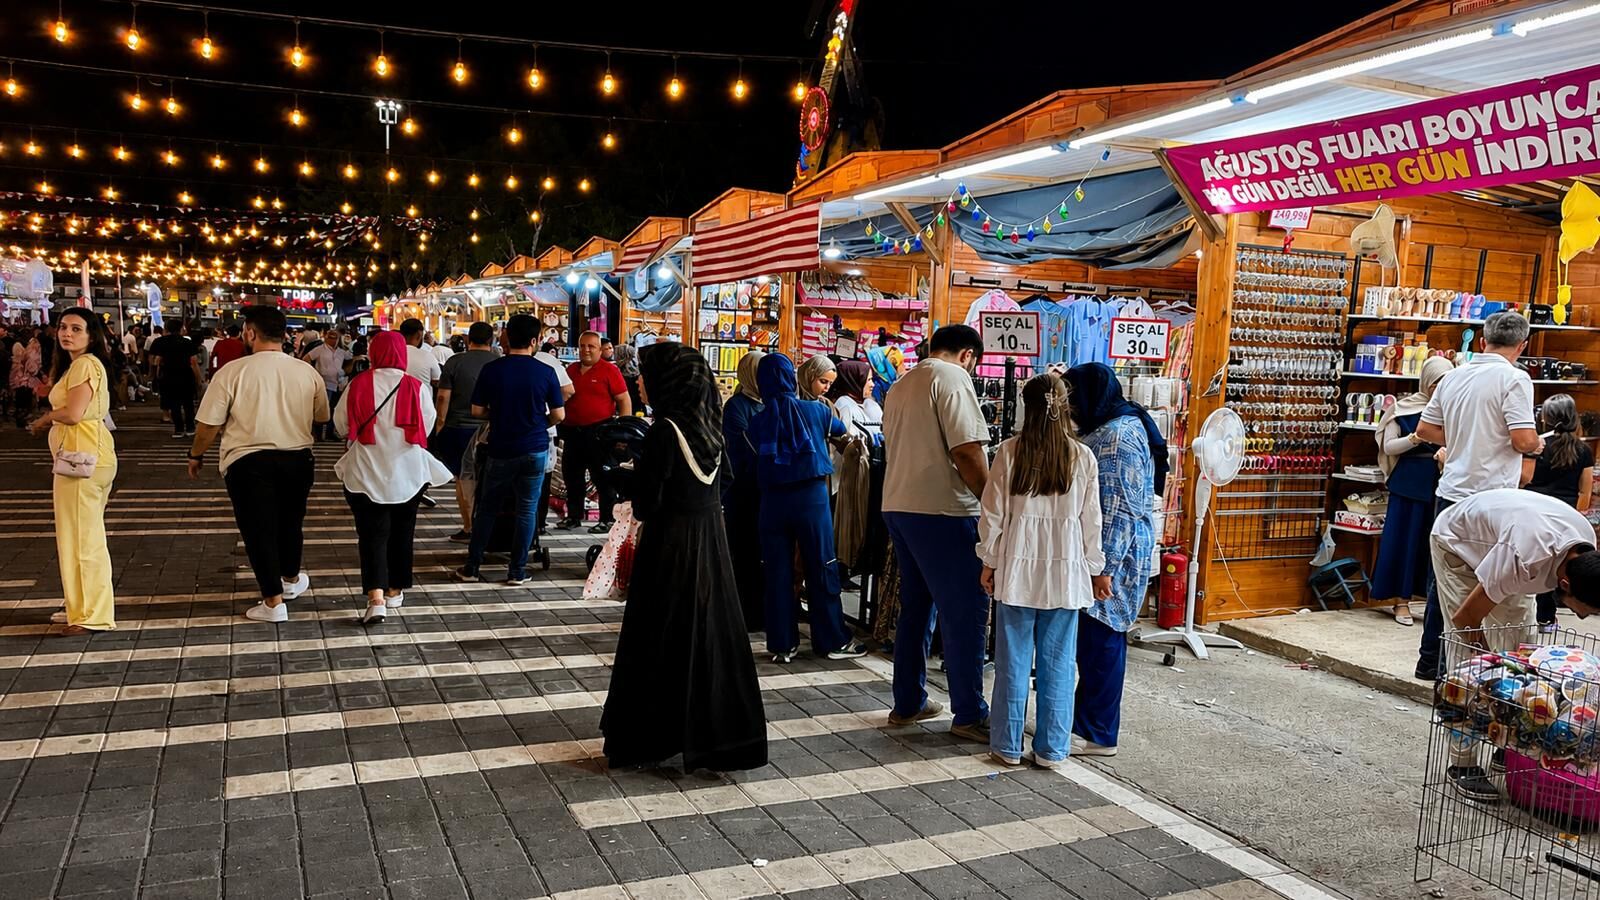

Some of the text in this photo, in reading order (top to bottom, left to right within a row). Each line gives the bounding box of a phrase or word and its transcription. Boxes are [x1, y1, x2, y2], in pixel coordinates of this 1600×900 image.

[1200, 140, 1320, 182] AĞUSTOS
[1318, 119, 1419, 164] FUARI
[1231, 178, 1275, 204] GÜN
[1269, 168, 1339, 201] DEĞİL
[1334, 162, 1397, 193] HER
[1397, 147, 1472, 185] GÜN
[985, 316, 1034, 331] SEÇ AL
[1117, 323, 1165, 338] SEÇ AL
[997, 333, 1031, 351] 10 TL
[1127, 339, 1161, 356] 30 TL
